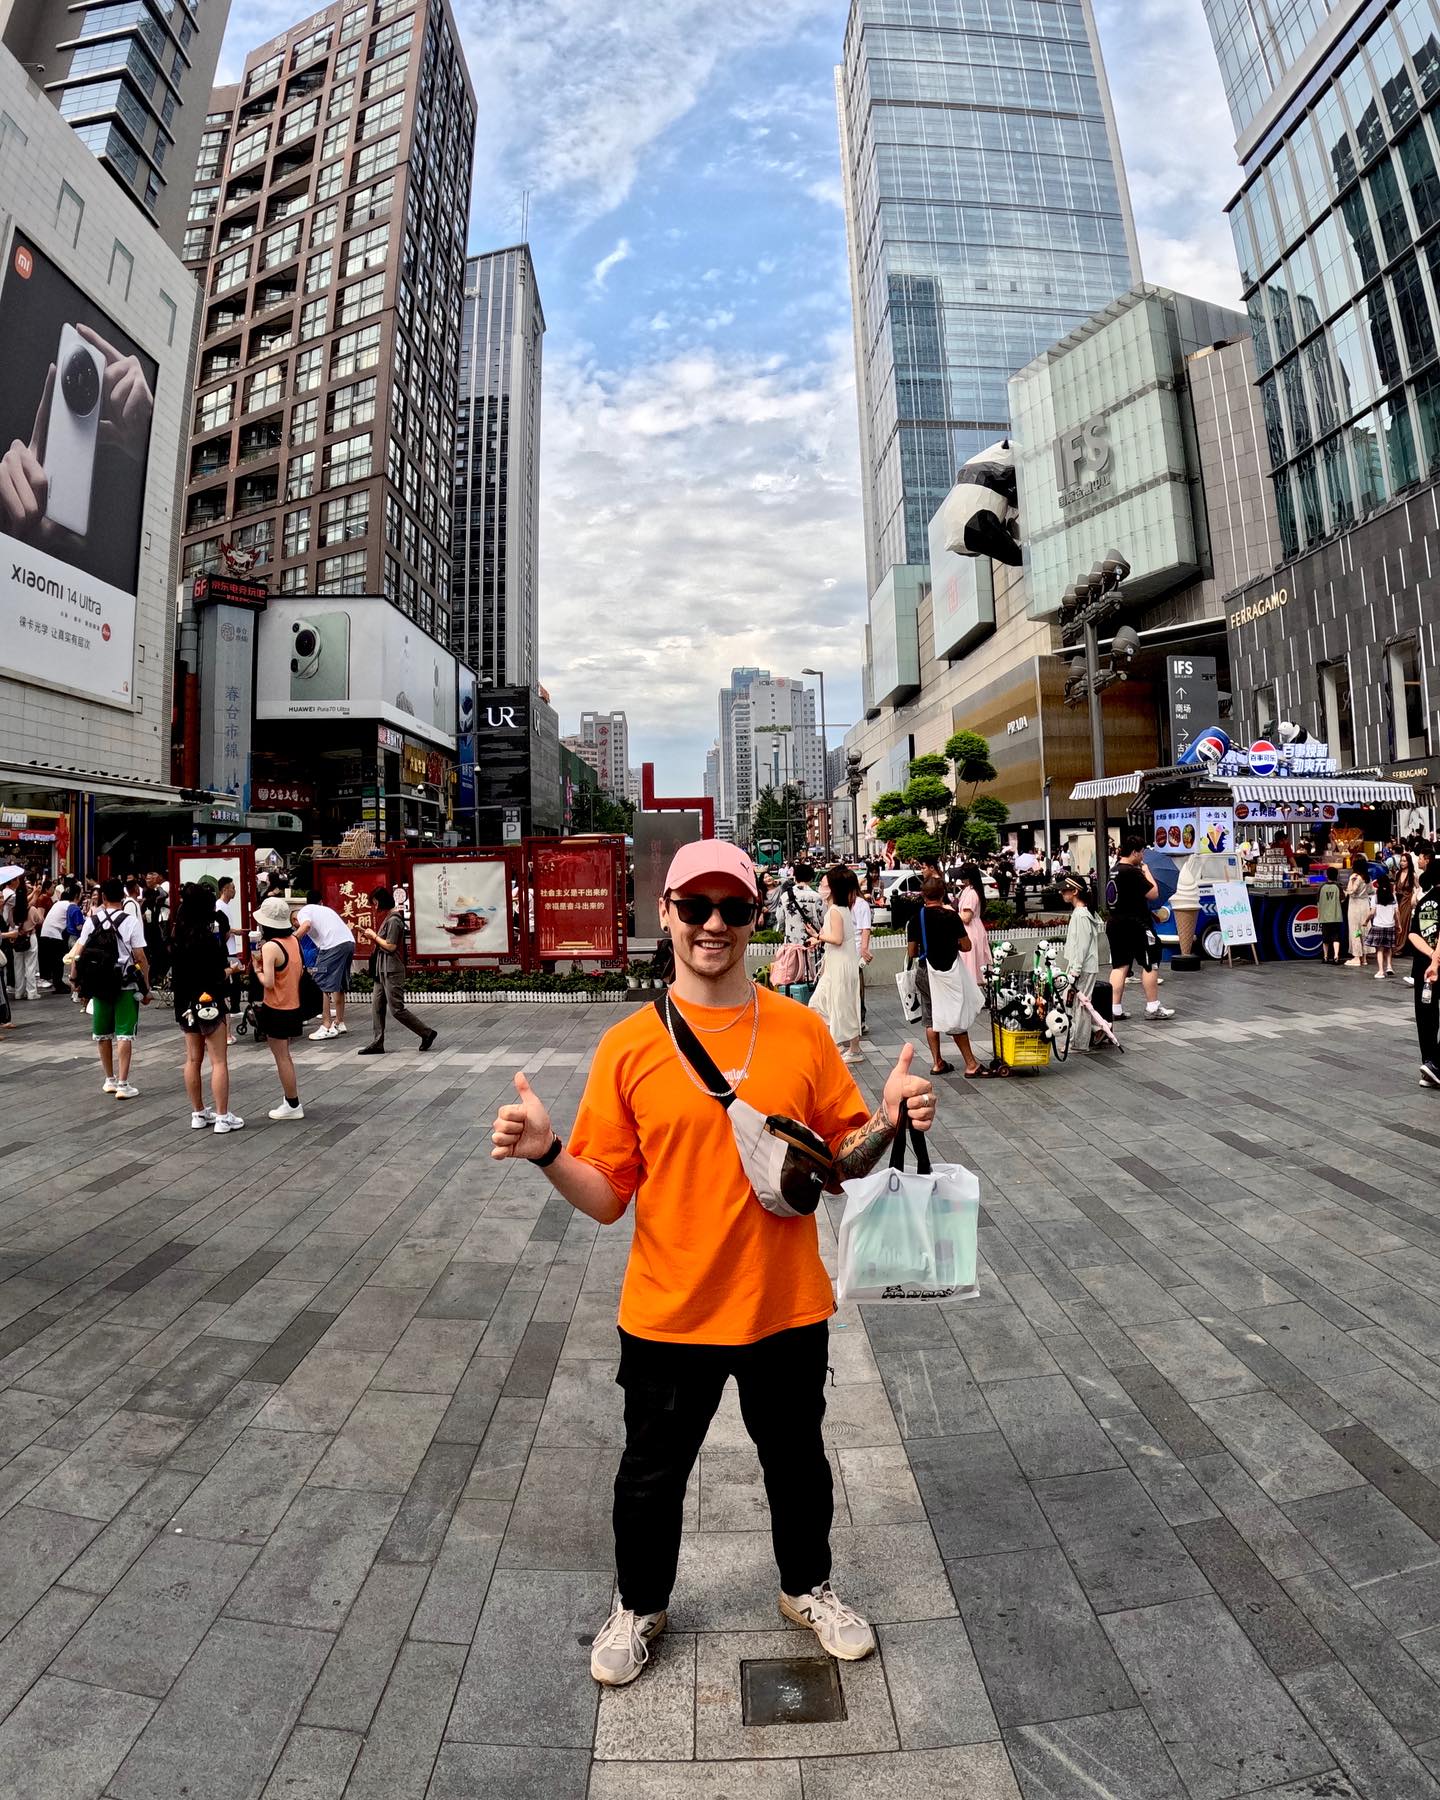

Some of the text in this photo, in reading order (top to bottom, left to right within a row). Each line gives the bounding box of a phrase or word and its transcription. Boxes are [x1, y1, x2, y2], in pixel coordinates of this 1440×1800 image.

[1052, 414, 1110, 492] IFS
[194, 579, 208, 598] 6F
[67, 588, 77, 604] 14
[79, 593, 102, 616] Ultra
[1230, 588, 1288, 630] FERRAGAMO
[51, 628, 91, 650] 让真实有层次
[1173, 660, 1194, 675] IFS
[486, 706, 519, 728] UR
[1175, 703, 1192, 713] 商场
[1007, 716, 1029, 736] PRADA
[1250, 754, 1276, 762] 百事可乐
[506, 824, 517, 838] P
[540, 888, 608, 897] 社会主义是干出来的
[1326, 891, 1334, 900] W
